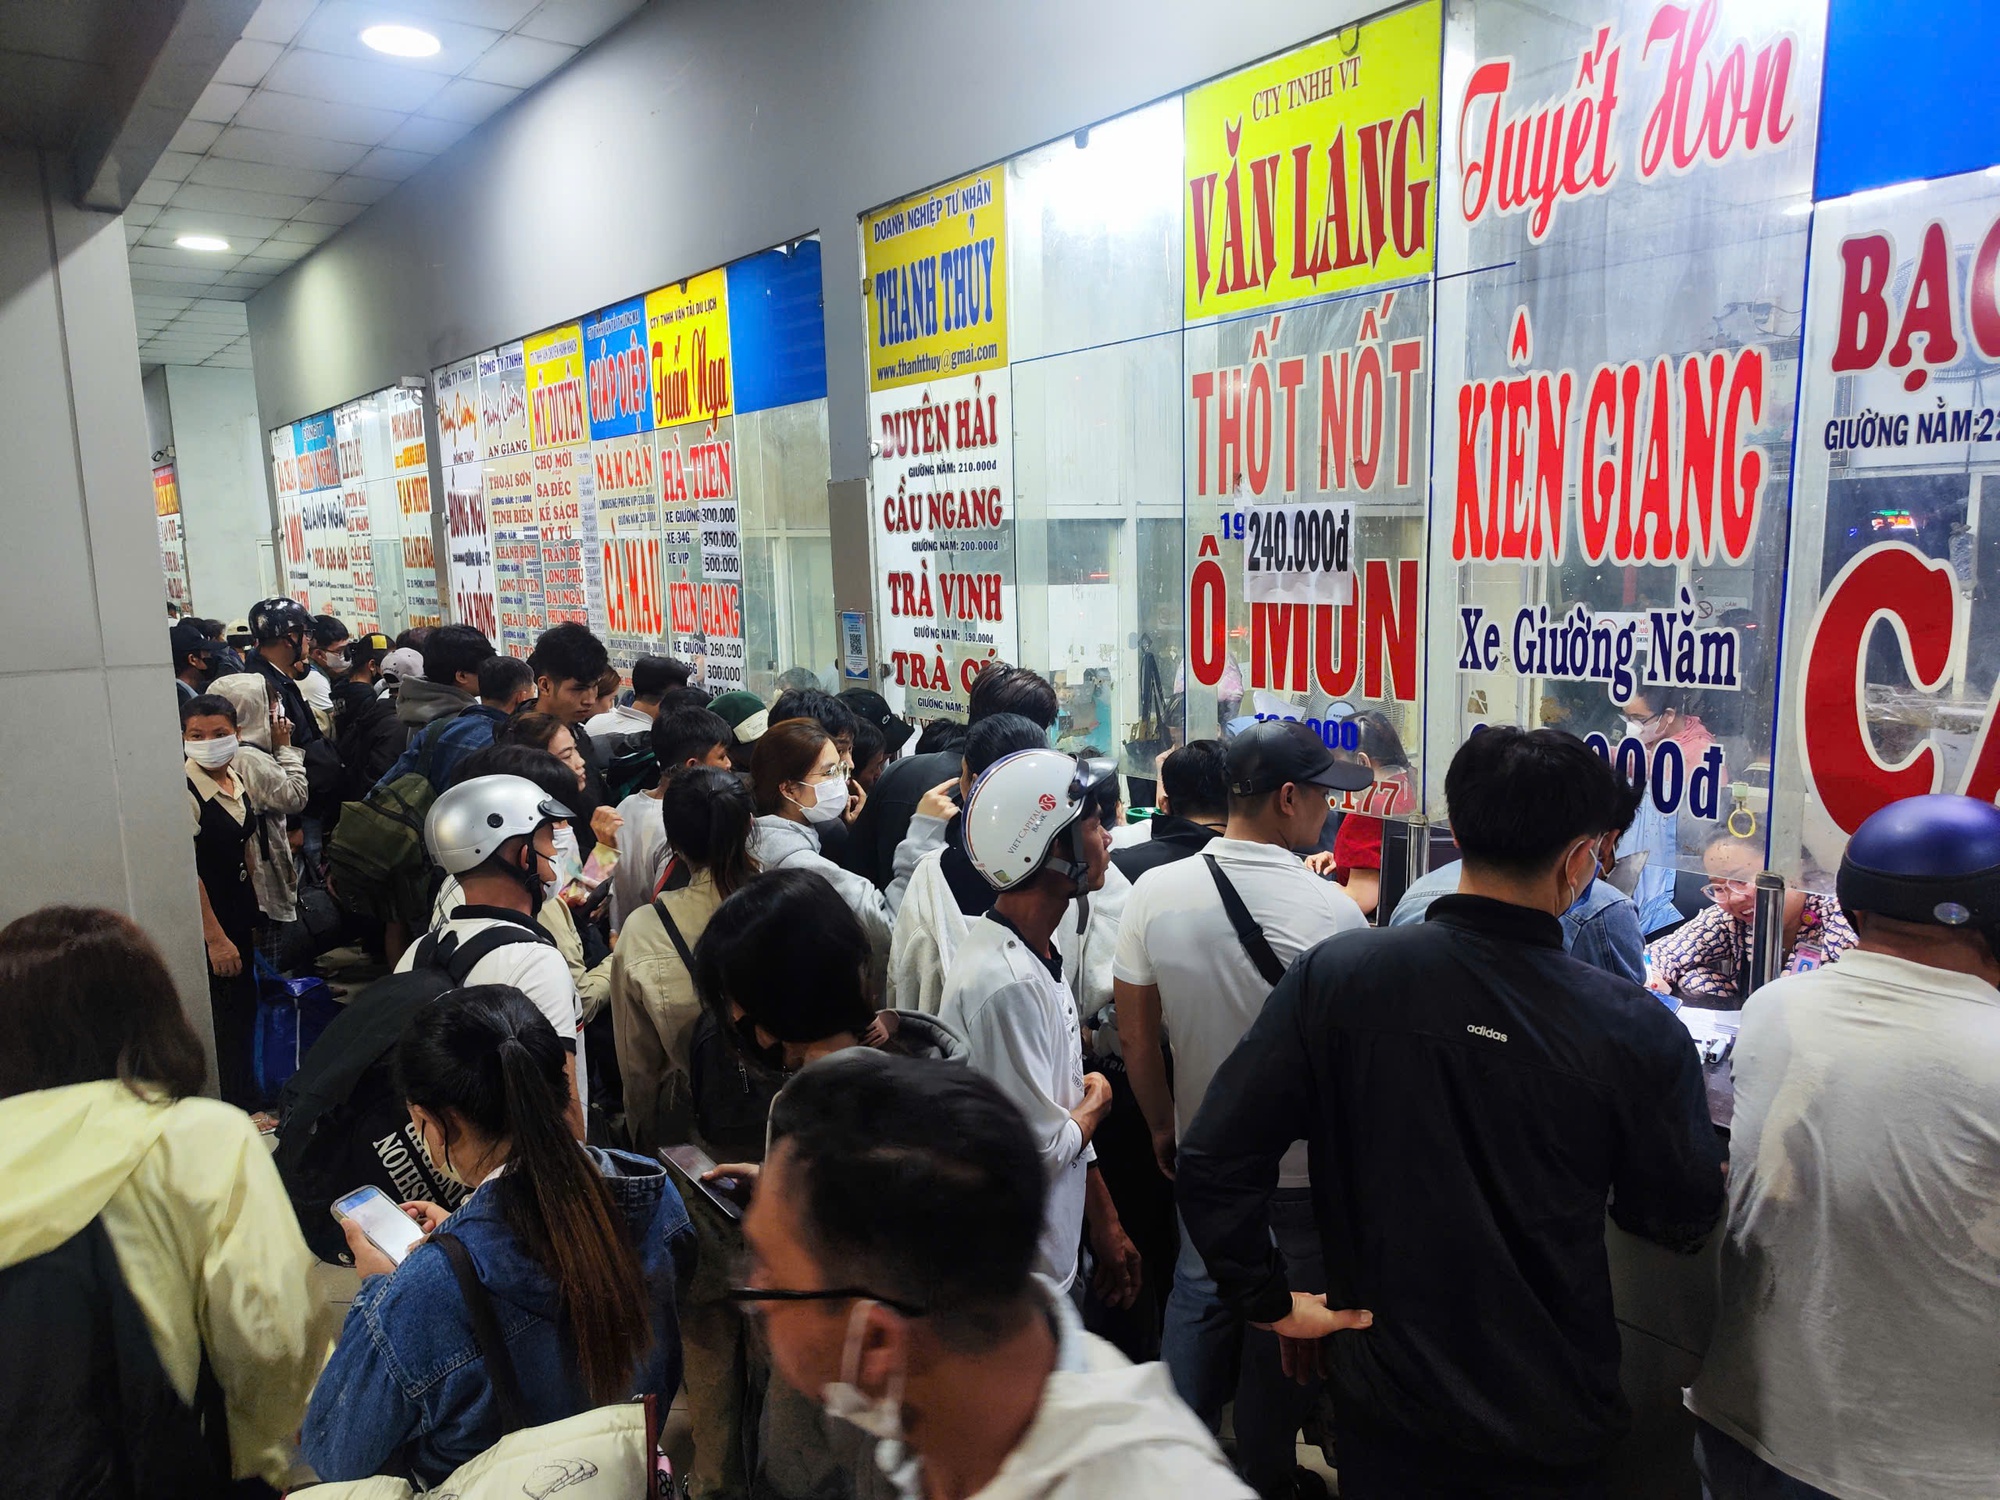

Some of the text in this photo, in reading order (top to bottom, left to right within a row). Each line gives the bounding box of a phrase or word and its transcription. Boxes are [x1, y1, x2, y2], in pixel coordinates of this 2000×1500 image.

[1253, 55, 1361, 122] CTY TNHH VT
[1460, 26, 1621, 238] Tuyết
[874, 178, 991, 243] DOANH NGHIỆP TƯ NHÂN
[1190, 97, 1430, 306] VĂN LANG
[876, 213, 995, 347] THANH THỦY
[650, 317, 660, 330] CTY
[660, 311, 674, 326] TNHH
[696, 305, 704, 317] DU
[480, 352, 523, 377] CÔNG TY TNHH
[589, 330, 647, 431] GIÁP DIỆP
[652, 326, 729, 431] Tuấn Nga
[548, 361, 585, 444] DUYÊN
[1192, 293, 1421, 496] THỐT NỐT
[881, 374, 998, 459] DUYÊN HẢI
[1824, 408, 1909, 451] GIƯỜNG
[488, 440, 527, 458] AN GIANG
[1452, 311, 1762, 561] KIÊN GIANG
[535, 453, 552, 473] CHỢ
[555, 448, 573, 467] MỚI
[596, 439, 654, 491] NĂM CĂN
[661, 426, 733, 502] HÀ TIÊN
[958, 459, 997, 473] 210.000đ
[489, 470, 531, 491] THOẠI SƠN
[537, 477, 571, 498] SA ĐÉC
[493, 506, 533, 527] TỊNH BIÊN
[539, 501, 579, 522] KẾ SÁCH
[665, 511, 674, 524] XE
[702, 507, 736, 523] 300.000
[884, 476, 1003, 532] CẦU NGANG
[541, 523, 555, 541] MỸ
[557, 521, 572, 540] TÚ
[666, 531, 738, 548] XE 34G 350.000
[960, 539, 999, 551] 200.000đ
[1247, 508, 1350, 573] 240.000đ
[542, 539, 581, 563] TRẦN ĐỀ
[667, 552, 739, 573] XE VIP 500.000
[499, 575, 540, 593] LONG XUYÊN
[545, 565, 584, 584] LONG PHÚ
[604, 517, 627, 633] CÀ
[626, 539, 662, 635] MAU
[888, 558, 1003, 621] TRÀ VINH
[546, 590, 562, 608] ĐẠI
[670, 568, 740, 638] KIÊN GIANG
[1191, 534, 1227, 685] Ô
[502, 608, 542, 628] CHÂU ĐỐC
[673, 641, 682, 653] XE
[965, 632, 994, 644] 190.000đ
[1459, 586, 1737, 703] Xe Giường Nằm
[707, 664, 740, 682] 300.000
[891, 644, 951, 692] TRÀ
[1008, 809, 1041, 855] VIET CAPITAL
[1466, 1024, 1508, 1043] adidas
